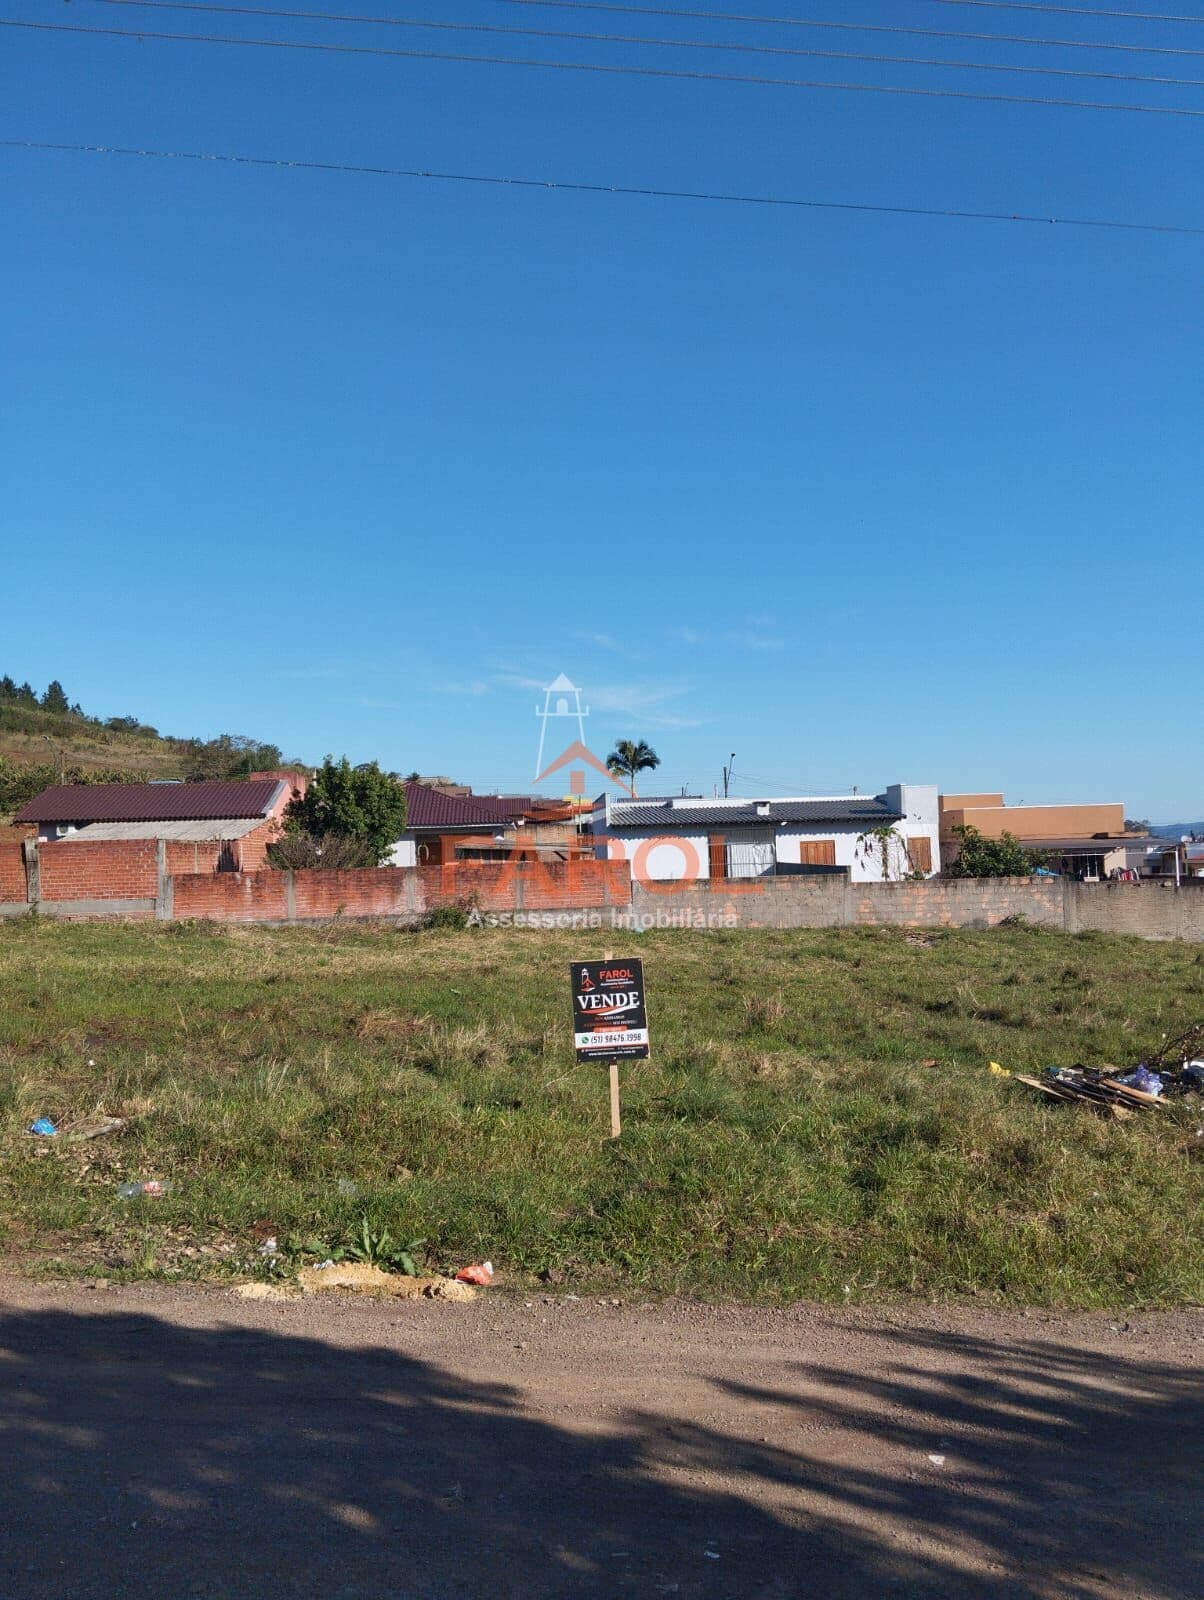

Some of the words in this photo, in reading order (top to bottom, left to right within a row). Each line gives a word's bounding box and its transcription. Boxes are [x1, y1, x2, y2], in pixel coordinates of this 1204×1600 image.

[599, 969, 634, 980] FAROL
[577, 991, 640, 1010] VENDE
[591, 1035, 603, 1044] (51)
[627, 1032, 642, 1042] 1998
